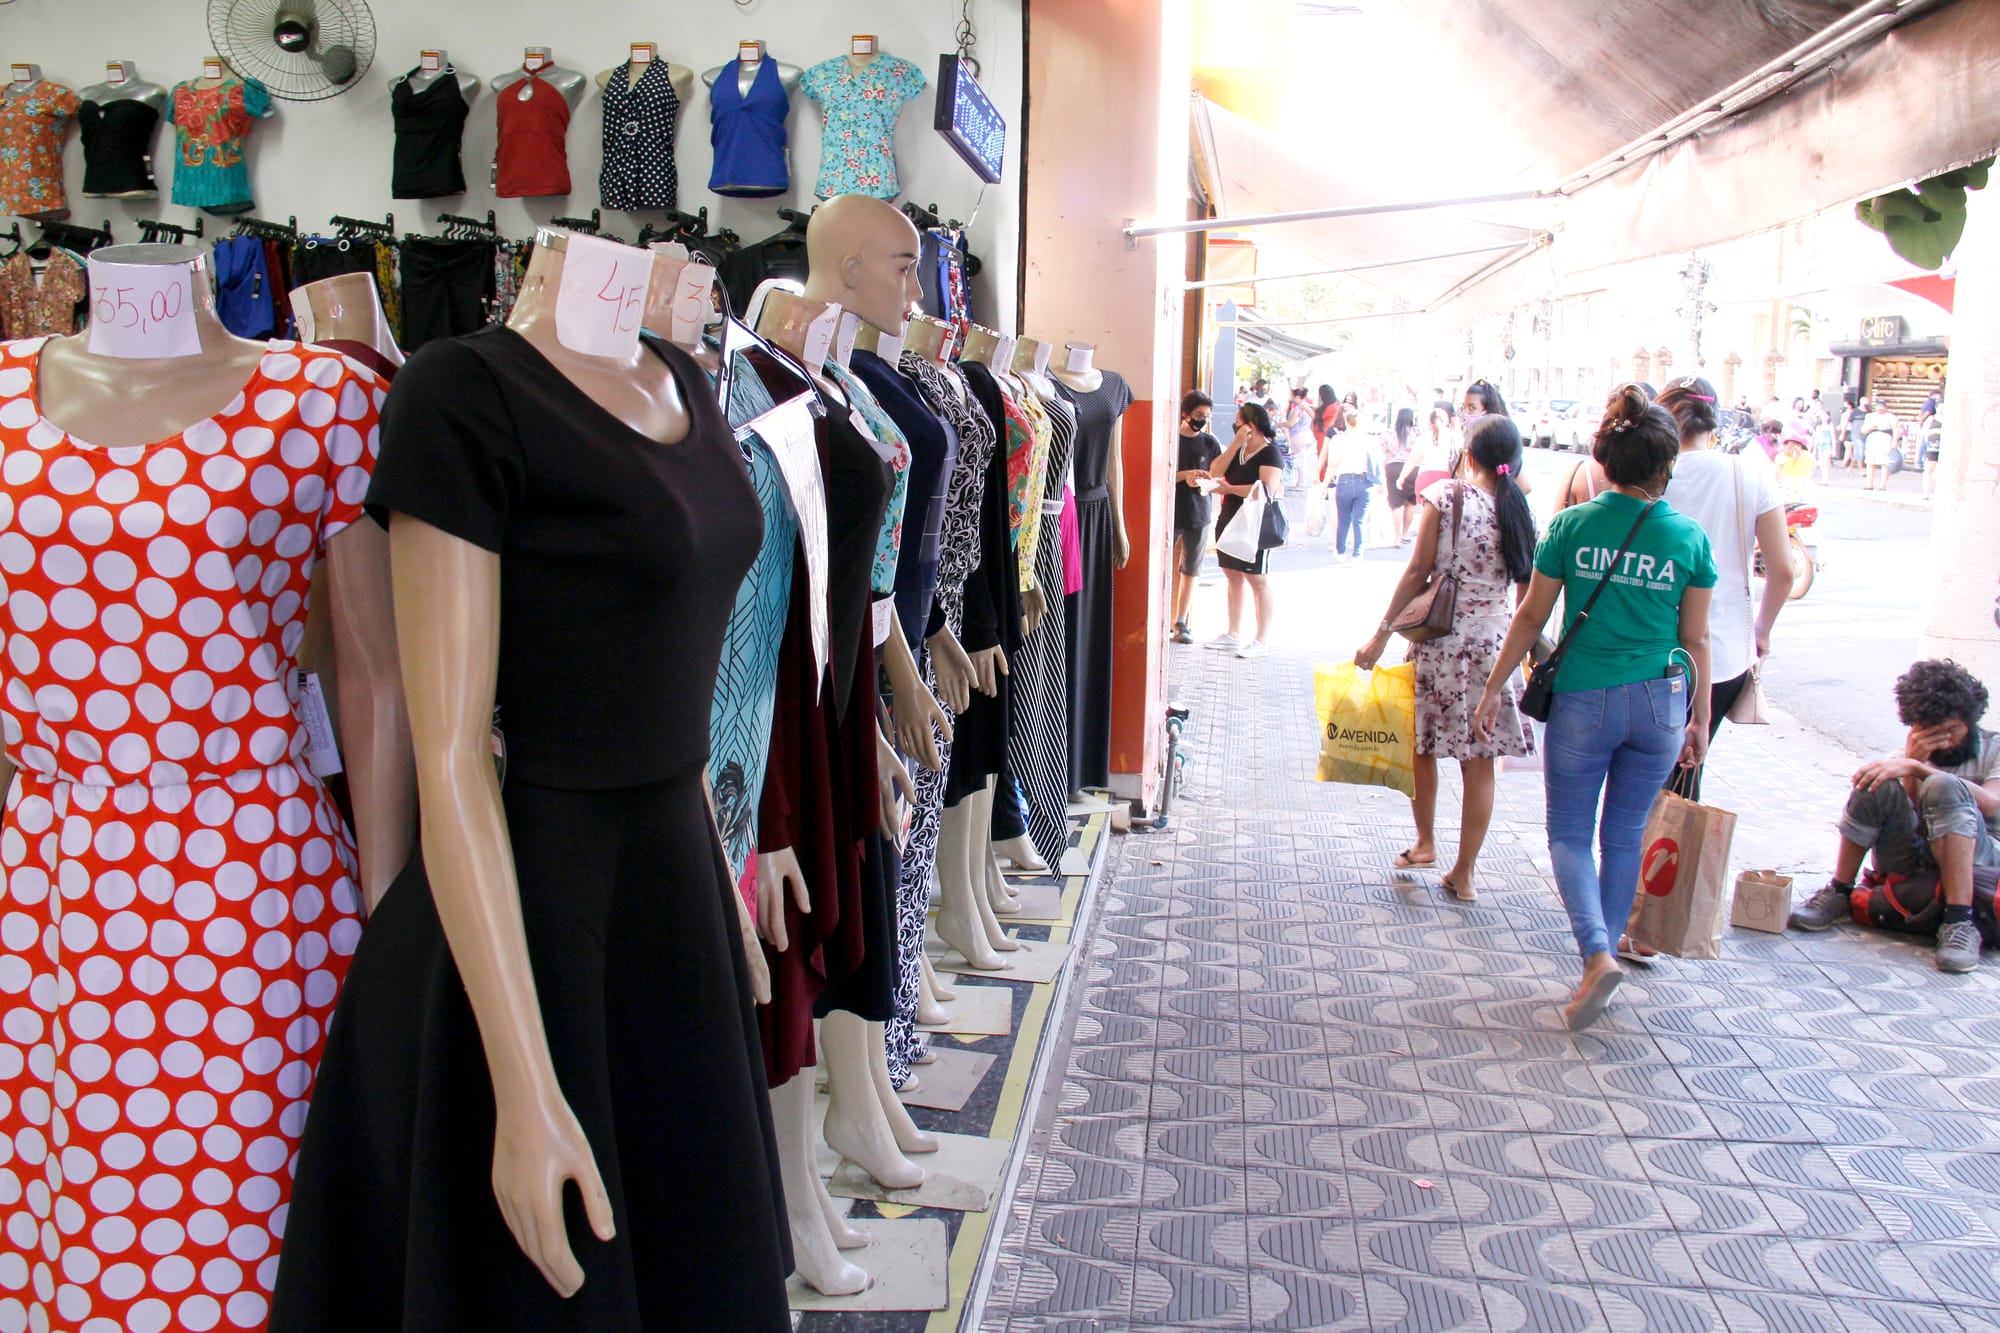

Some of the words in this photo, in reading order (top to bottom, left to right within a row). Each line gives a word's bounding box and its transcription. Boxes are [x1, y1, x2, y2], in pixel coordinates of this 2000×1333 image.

[94, 280, 182, 337] 35,00
[597, 259, 645, 335] 45
[1575, 546, 1676, 583] CINTRA
[1339, 727, 1399, 744] AVENIDA
